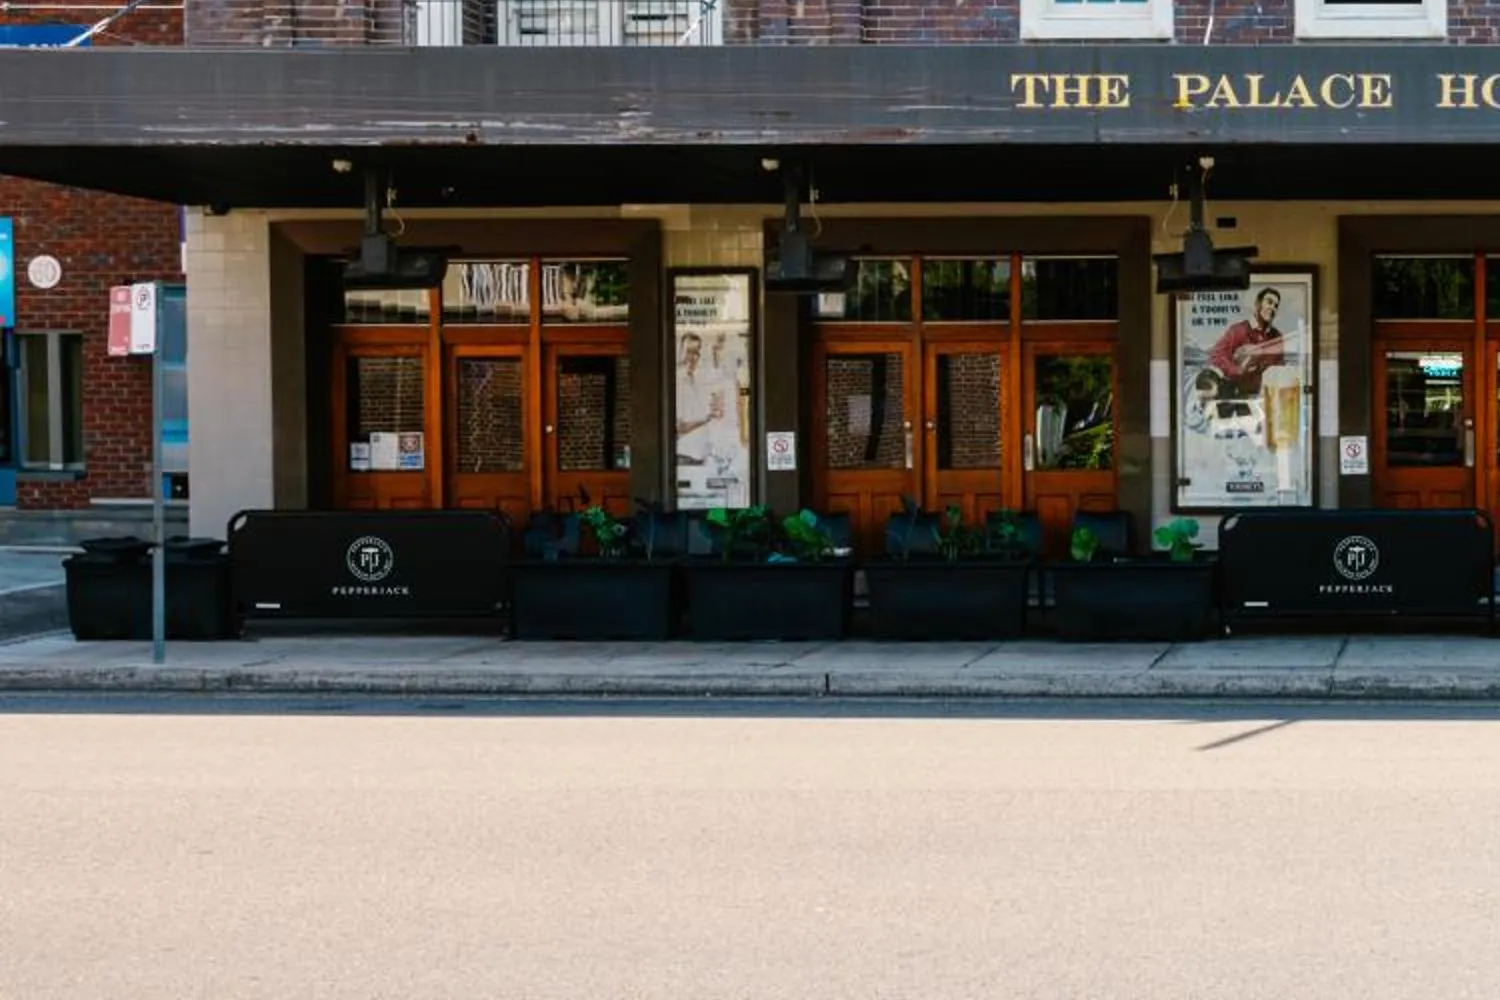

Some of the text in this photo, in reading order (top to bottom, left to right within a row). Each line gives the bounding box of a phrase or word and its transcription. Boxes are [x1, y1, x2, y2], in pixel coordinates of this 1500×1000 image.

[1010, 73, 1130, 109] THE
[1172, 72, 1393, 109] PALACE
[332, 586, 409, 595] PEPPERJACK
[1319, 585, 1393, 594] PEPPERJACK
